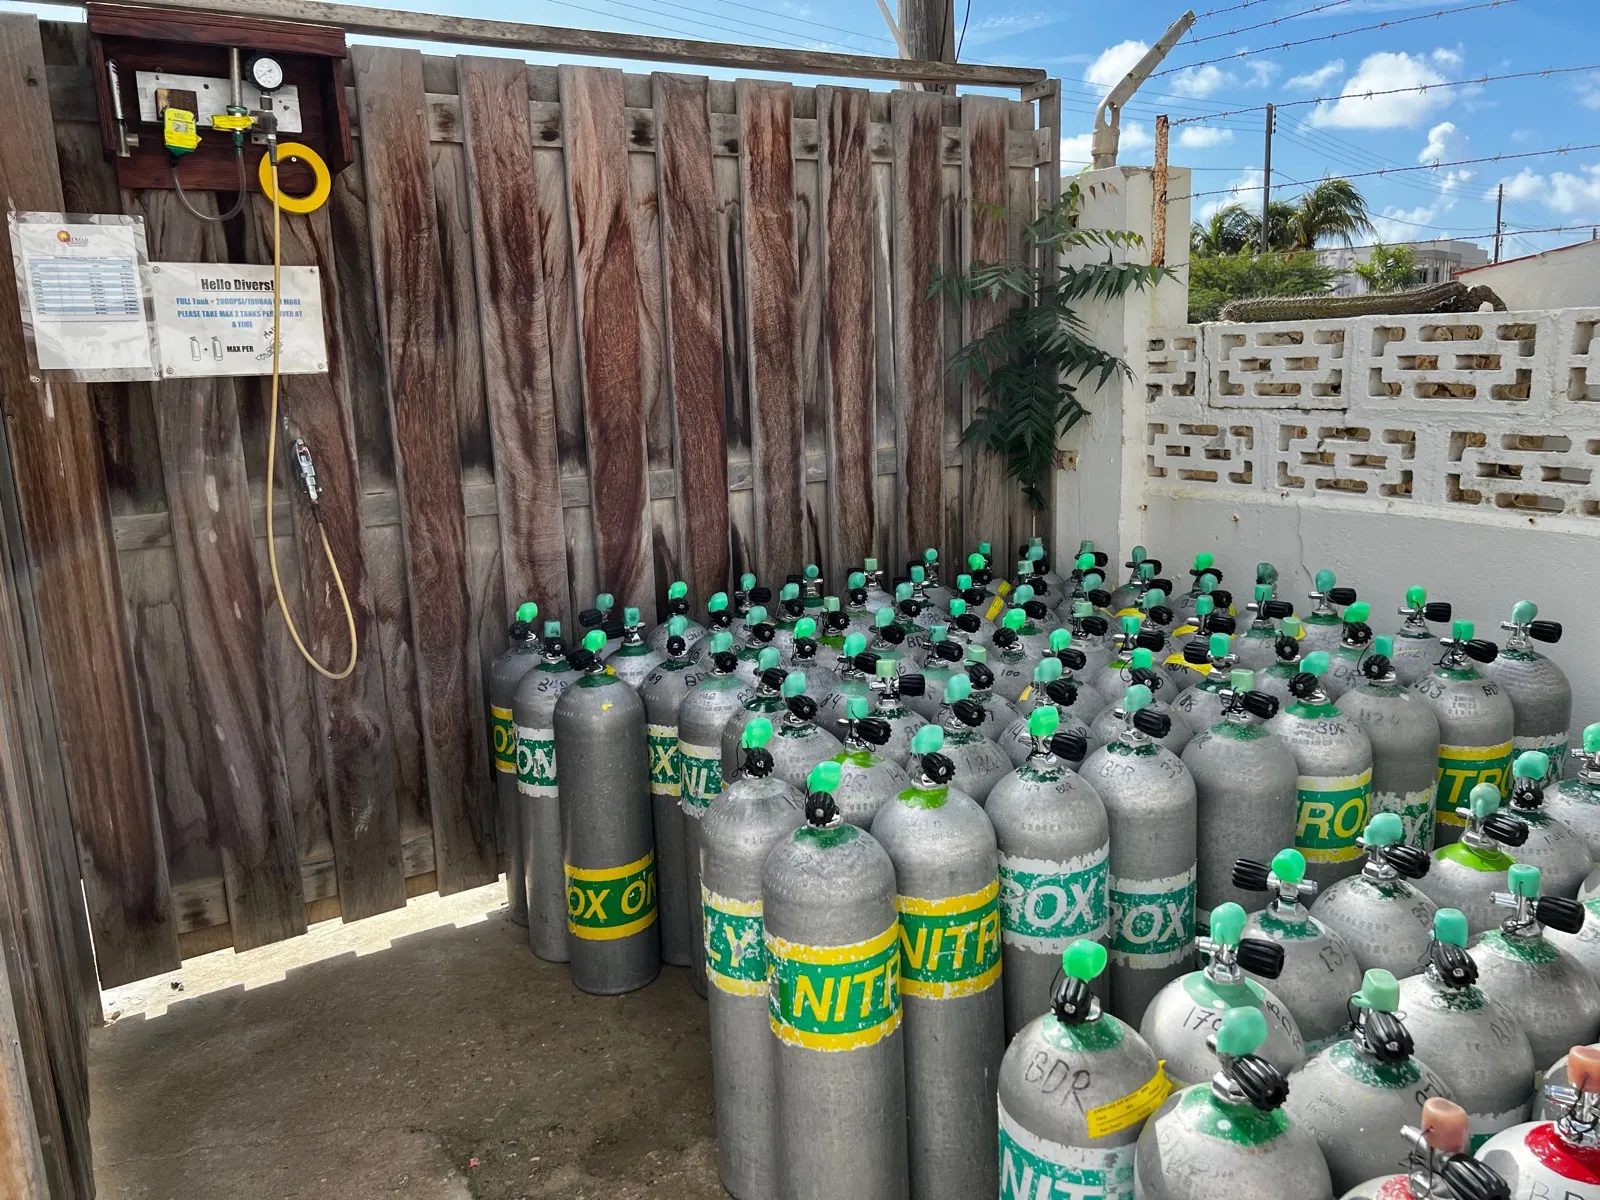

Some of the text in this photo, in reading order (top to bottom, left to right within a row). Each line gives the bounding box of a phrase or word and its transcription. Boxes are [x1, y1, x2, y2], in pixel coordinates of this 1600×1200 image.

[201, 279, 275, 291] Hello Divers!
[177, 310, 200, 318] PLEASE
[202, 310, 218, 318] TAKE
[219, 310, 233, 318] MAX
[226, 345, 254, 353] MAX PER
[685, 672, 708, 687] BD
[820, 693, 842, 709] 84
[682, 762, 721, 800] NL
[568, 886, 610, 919] OX
[900, 909, 998, 971] NITR
[1025, 1051, 1091, 1115] BDR
